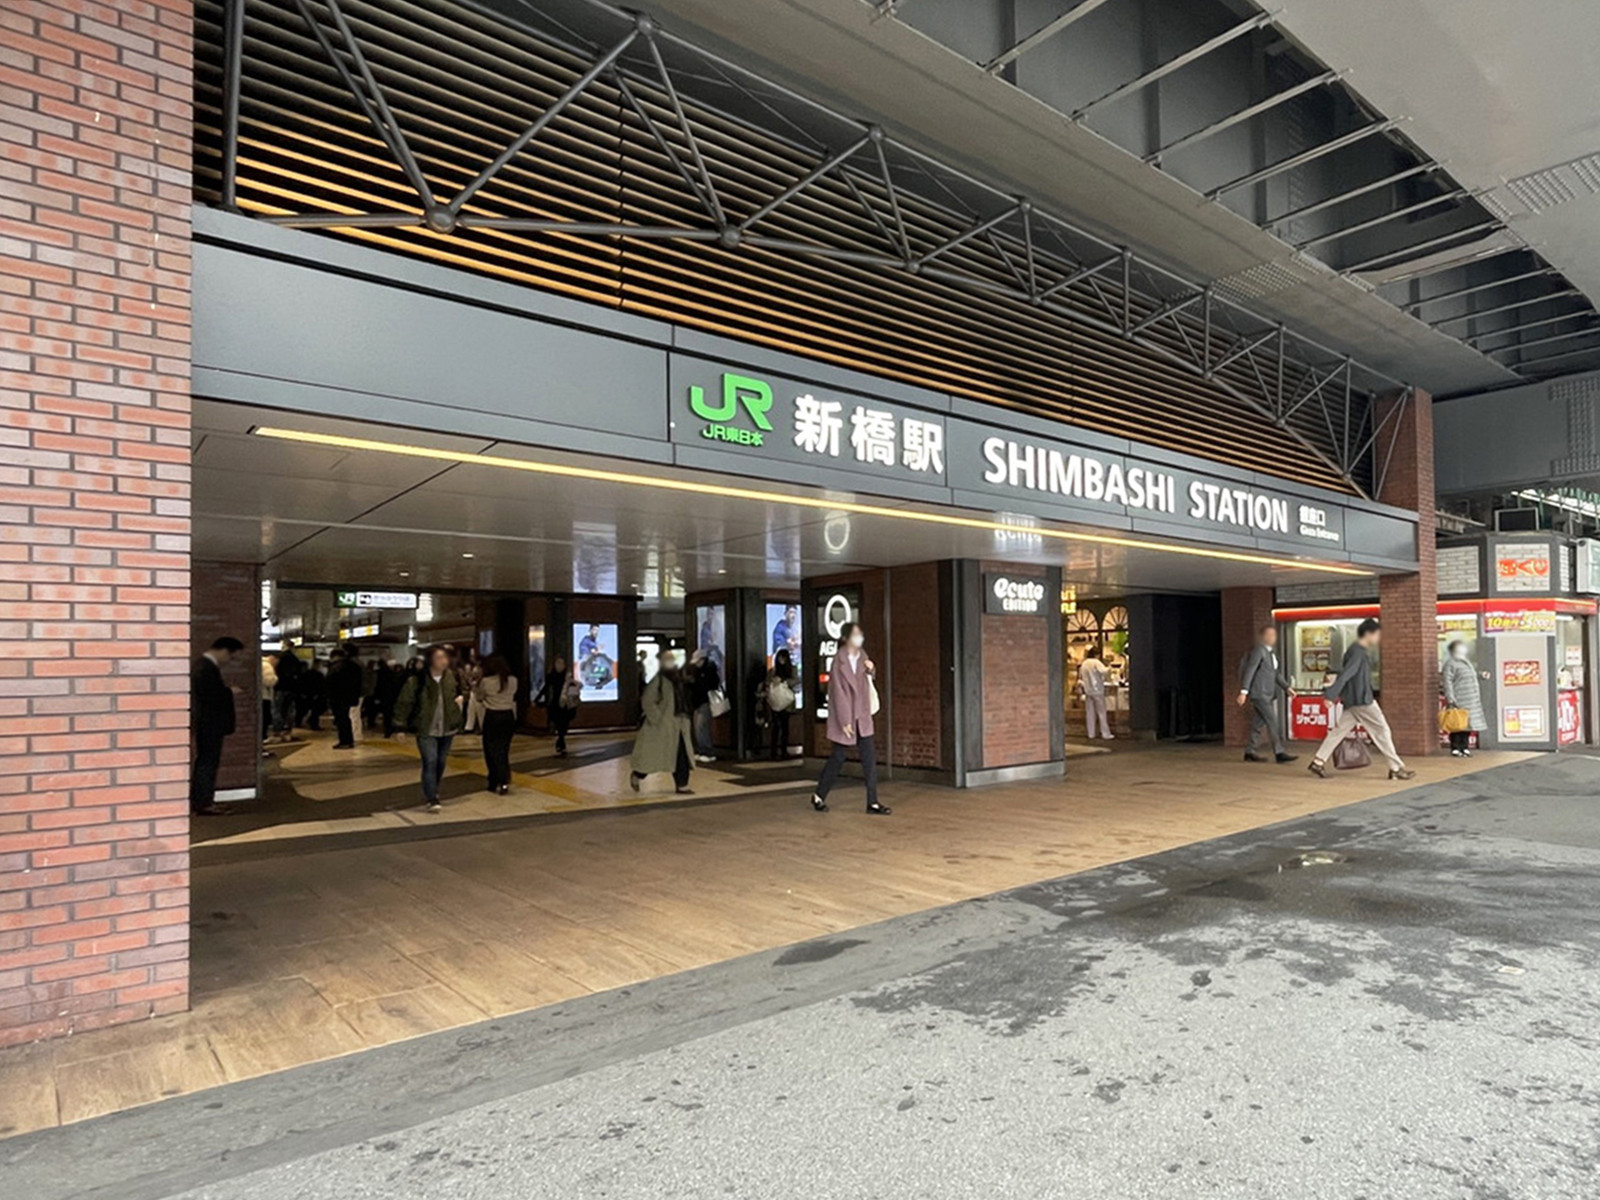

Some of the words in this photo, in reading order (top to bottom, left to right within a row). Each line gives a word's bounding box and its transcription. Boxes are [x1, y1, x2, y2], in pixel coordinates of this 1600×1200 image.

[690, 373, 773, 430] JR
[702, 424, 764, 446] JR東日本
[793, 394, 944, 475] 新橋駅
[983, 437, 1176, 514] SHIMBASHI
[1188, 481, 1289, 534] STATION
[994, 577, 1044, 600] ecute
